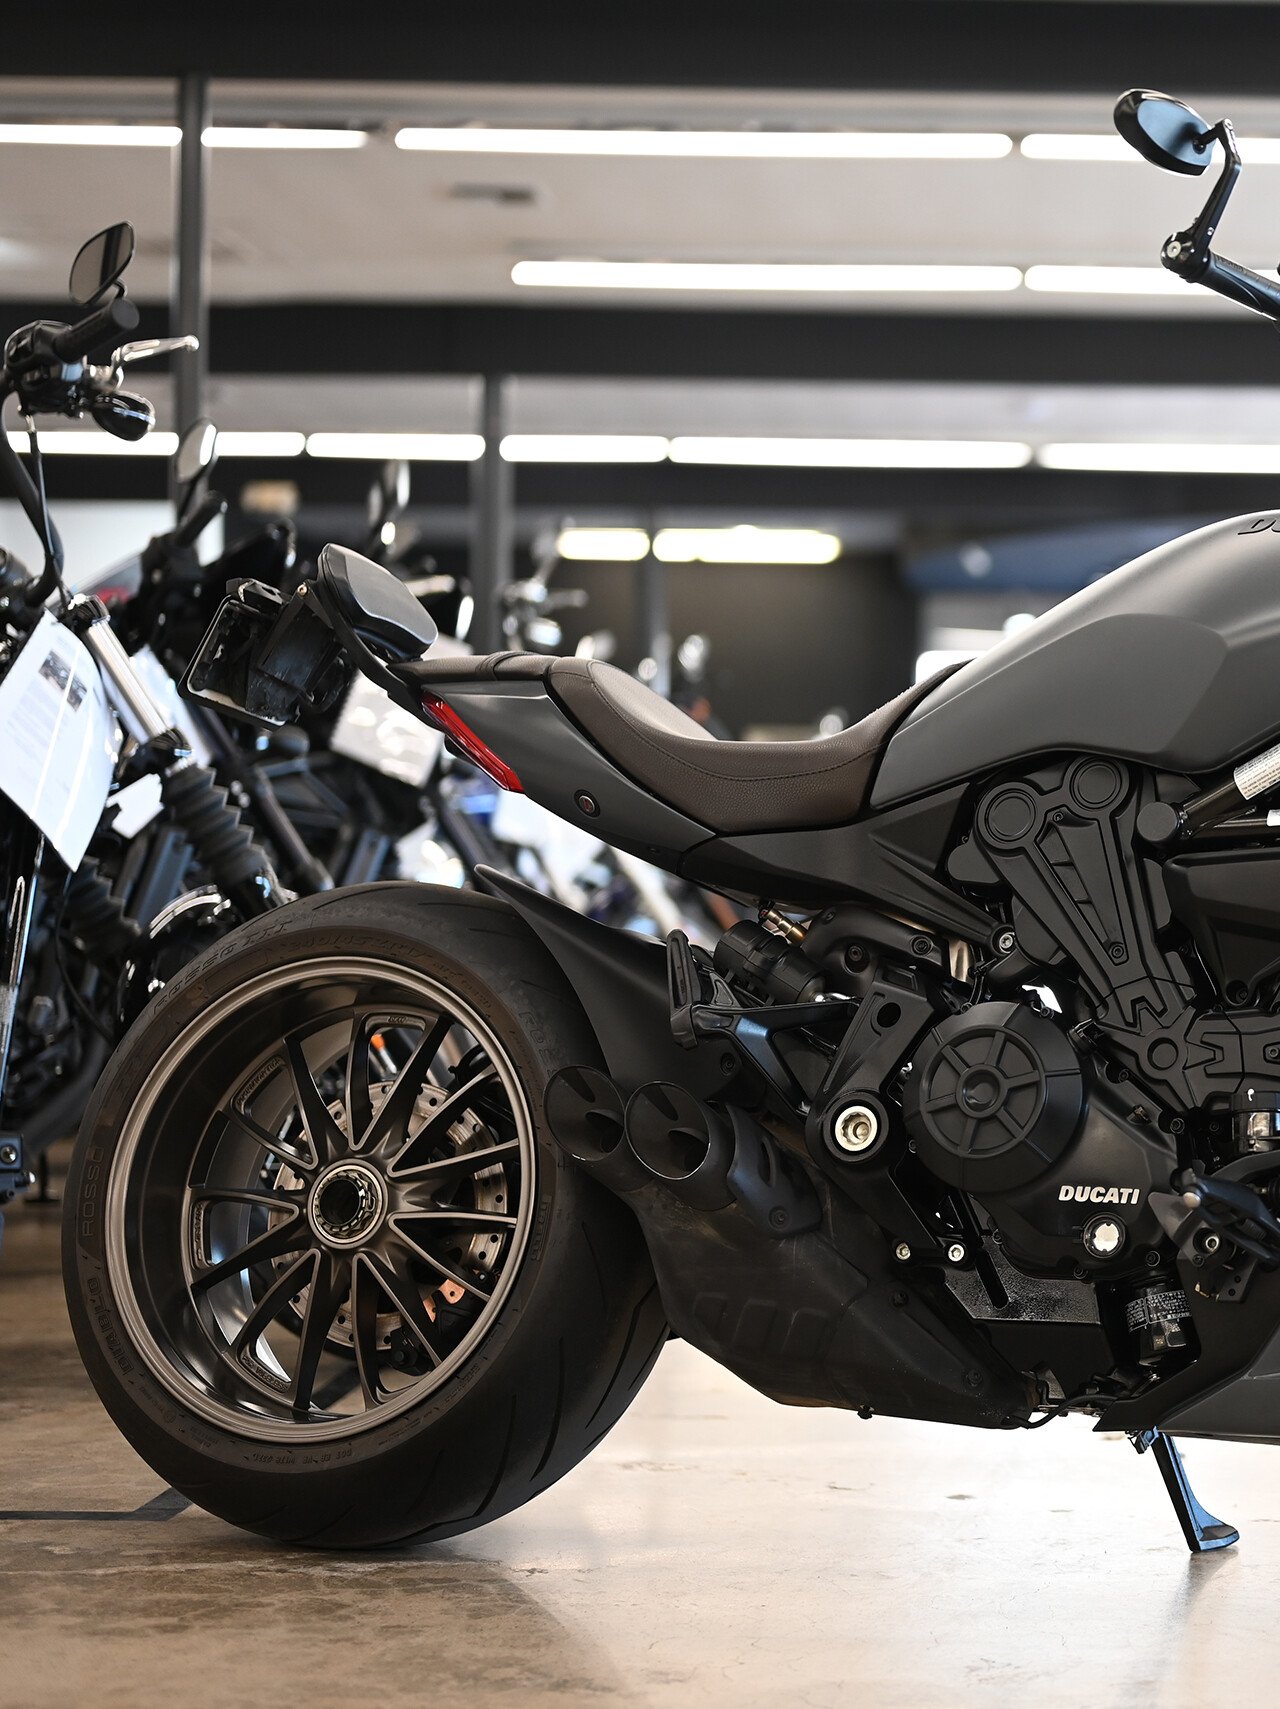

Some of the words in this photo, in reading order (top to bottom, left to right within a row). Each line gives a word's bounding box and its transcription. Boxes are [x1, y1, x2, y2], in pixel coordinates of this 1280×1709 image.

[82, 1145, 105, 1237] ROSSO
[1058, 1185, 1140, 1205] DUCATI
[85, 1276, 134, 1376] DIABLO
